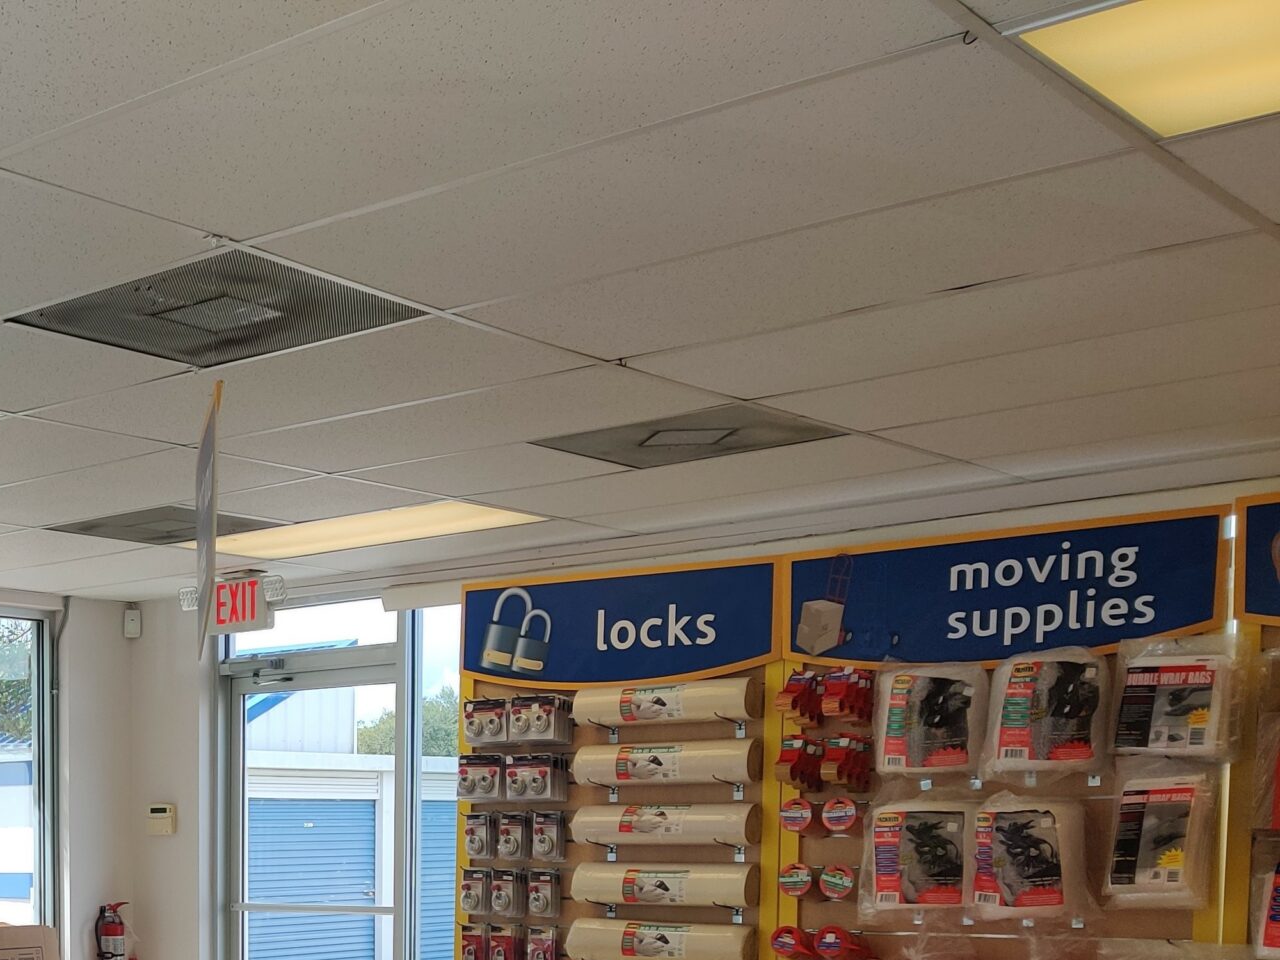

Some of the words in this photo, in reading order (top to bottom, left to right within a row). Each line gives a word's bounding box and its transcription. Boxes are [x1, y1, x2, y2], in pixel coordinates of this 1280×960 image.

[948, 541, 1140, 592] moving
[216, 580, 259, 625] EXIT
[946, 589, 1156, 646] supplies
[596, 603, 717, 651] locks
[1159, 672, 1187, 685] WRAP
[1188, 671, 1212, 684] BAGS
